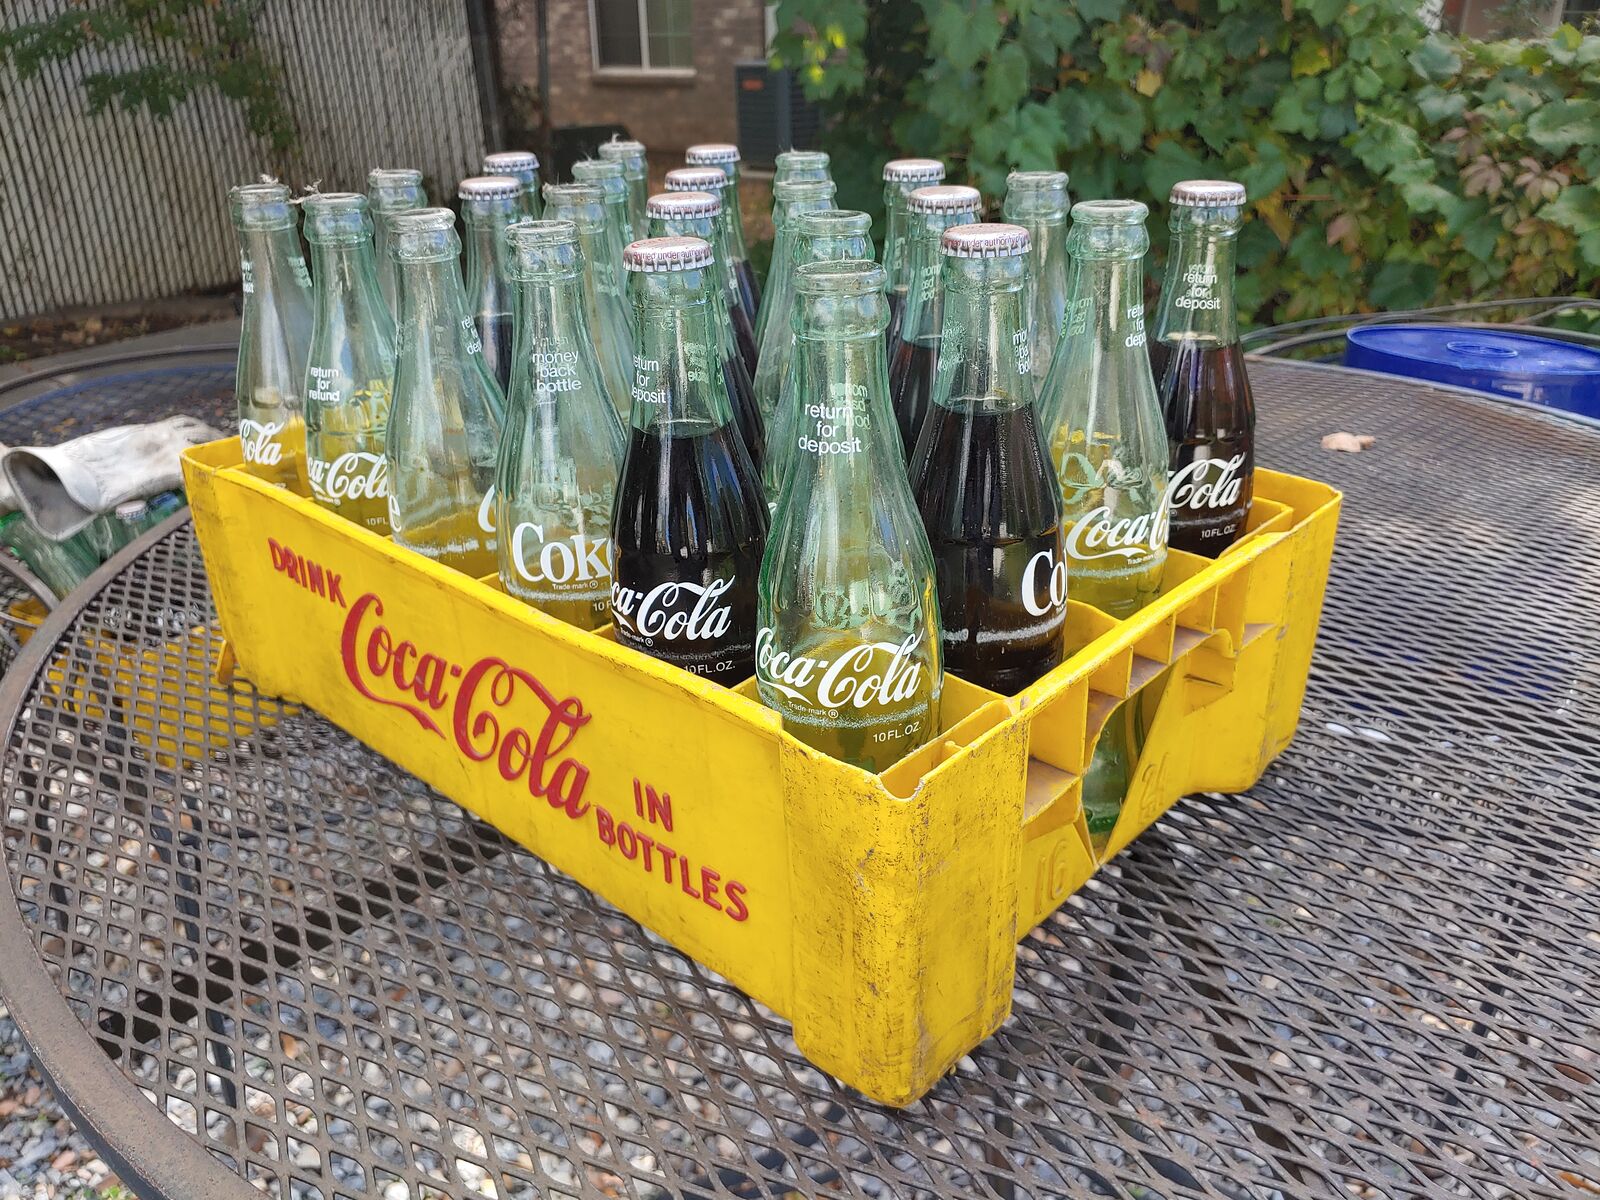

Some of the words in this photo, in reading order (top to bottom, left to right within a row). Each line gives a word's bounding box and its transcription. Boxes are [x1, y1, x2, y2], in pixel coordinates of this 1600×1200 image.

[657, 250, 679, 260] under
[1182, 272, 1217, 284] return
[1191, 283, 1209, 298] for
[1174, 295, 1221, 311] deposit
[532, 351, 579, 364] money
[633, 355, 659, 372] eturn
[310, 366, 339, 379] return
[540, 364, 577, 378] back
[636, 370, 650, 388] for
[317, 378, 331, 390] for
[536, 379, 582, 393] bottle
[309, 389, 340, 401] refund
[804, 402, 853, 419] return
[816, 420, 839, 438] for
[798, 434, 862, 456] deposit
[512, 522, 611, 583] Cok
[267, 537, 346, 609] DRINK
[1021, 548, 1067, 617] Co
[610, 574, 736, 641] ca-Cola
[755, 627, 925, 710] Coca-Cola
[340, 592, 593, 820] Coca-Cola
[632, 777, 674, 833] IN
[596, 805, 750, 923] BOTTLES
